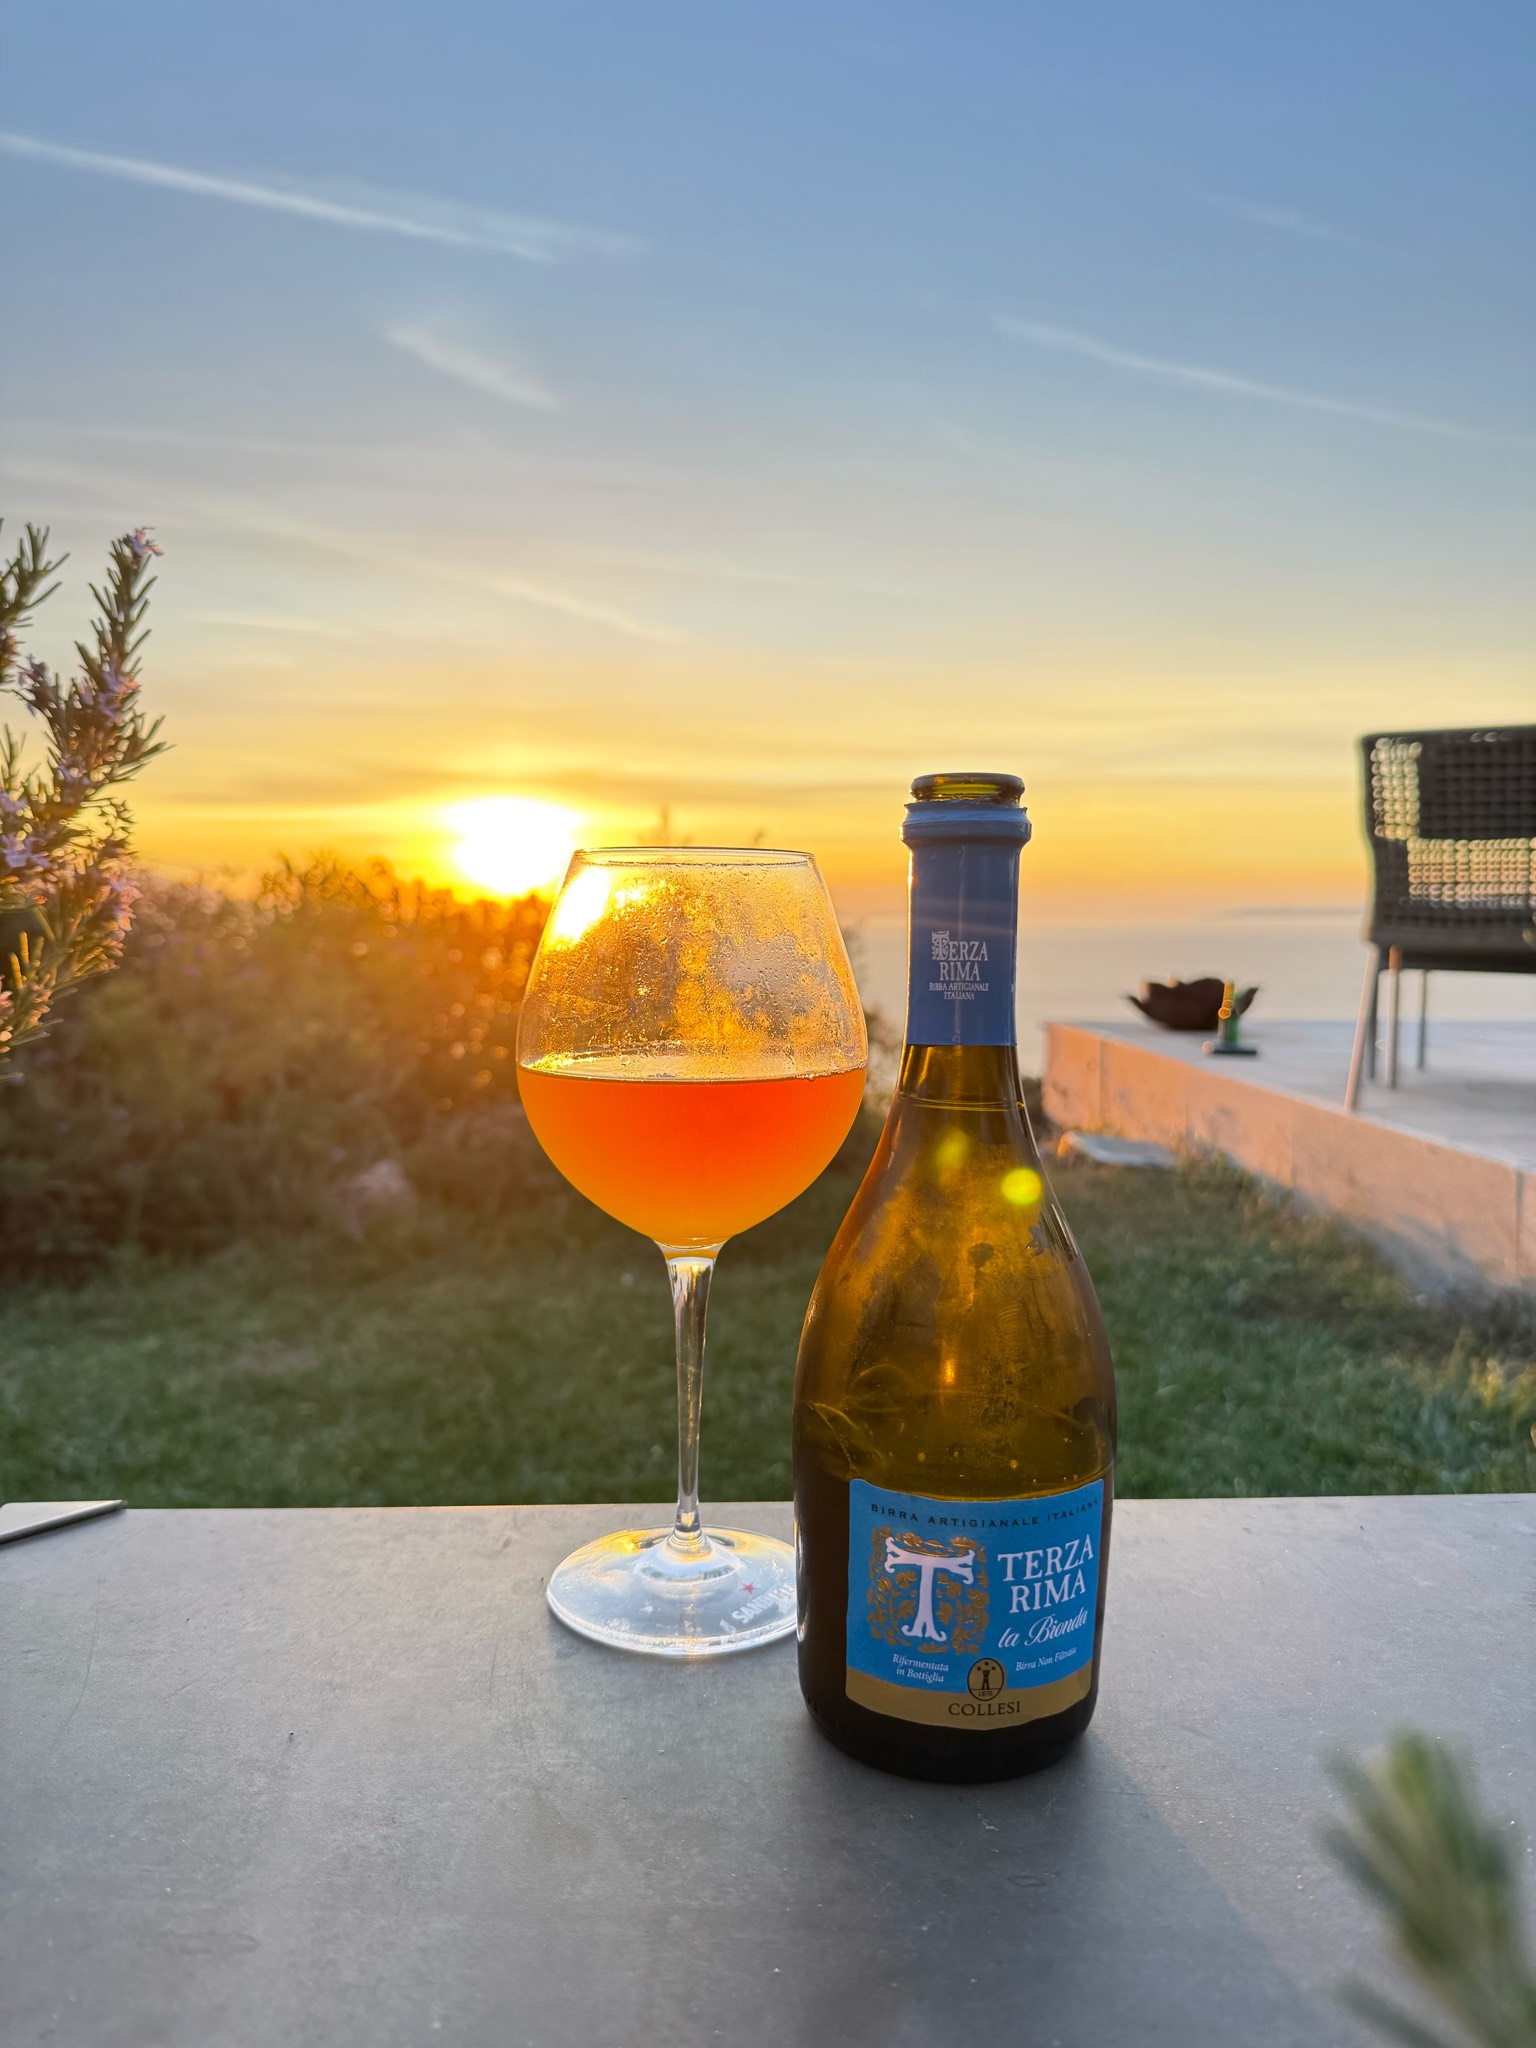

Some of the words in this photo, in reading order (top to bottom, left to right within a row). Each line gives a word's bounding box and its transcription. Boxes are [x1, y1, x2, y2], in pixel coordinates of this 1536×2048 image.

[931, 930, 988, 961] TERZA
[939, 961, 981, 981] RIMA
[944, 991, 975, 1000] ITALIANA
[871, 1503, 919, 1522] BIRRA
[927, 1515, 1040, 1528] ARTIGIANALE
[1046, 1497, 1099, 1522] ITALIANA
[997, 1533, 1094, 1582] TERZA
[1009, 1568, 1087, 1614] RIMA
[1024, 1606, 1088, 1646] Bionda
[892, 1653, 949, 1672] Rifermentata
[1015, 1661, 1037, 1672] Birra
[1037, 1656, 1053, 1668] Non
[896, 1666, 905, 1676] in
[907, 1668, 945, 1684] Bottiglia
[948, 1701, 1021, 1717] COLLESI
